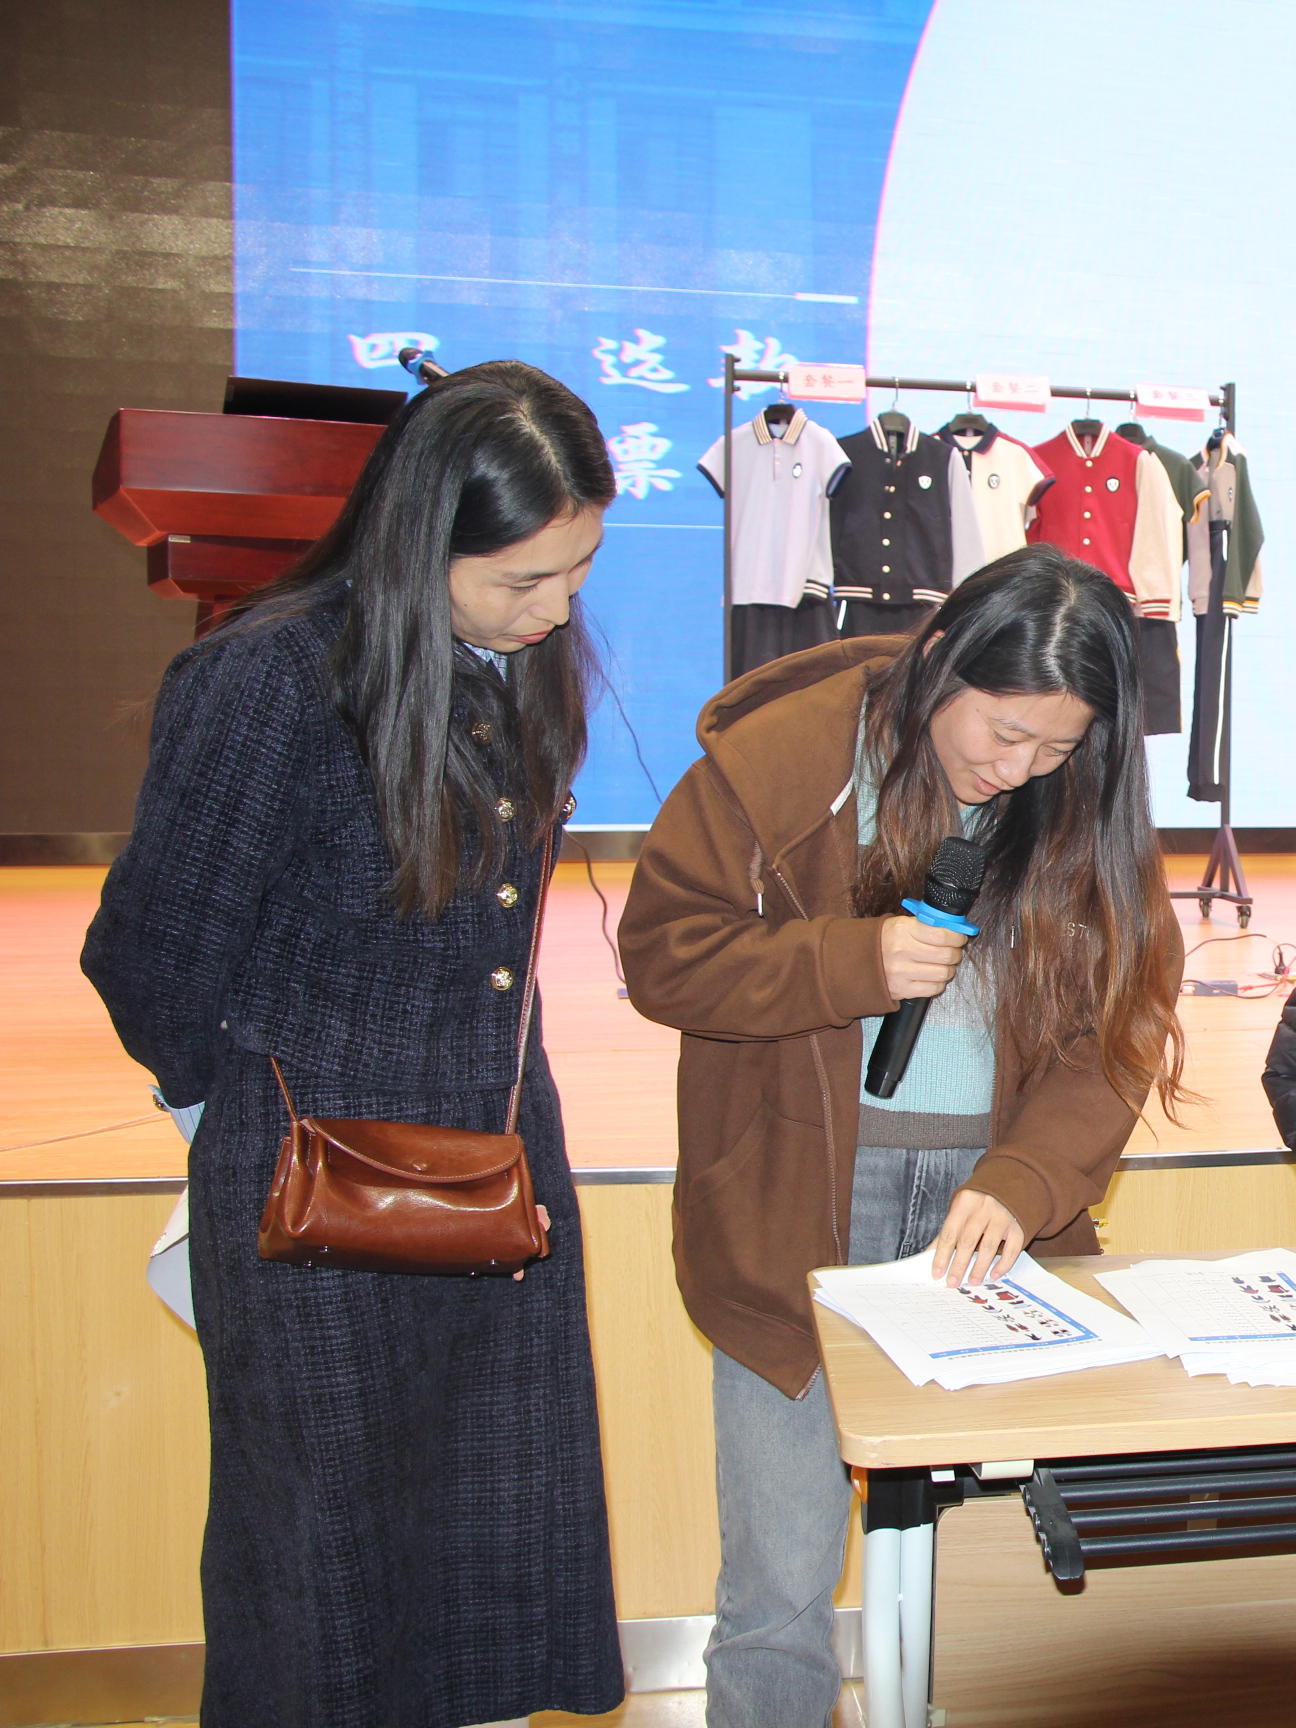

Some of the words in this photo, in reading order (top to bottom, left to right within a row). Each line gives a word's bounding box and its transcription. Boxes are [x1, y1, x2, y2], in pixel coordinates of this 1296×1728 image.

[803, 373, 854, 388] 套餐一
[990, 381, 1039, 394] 套餐二
